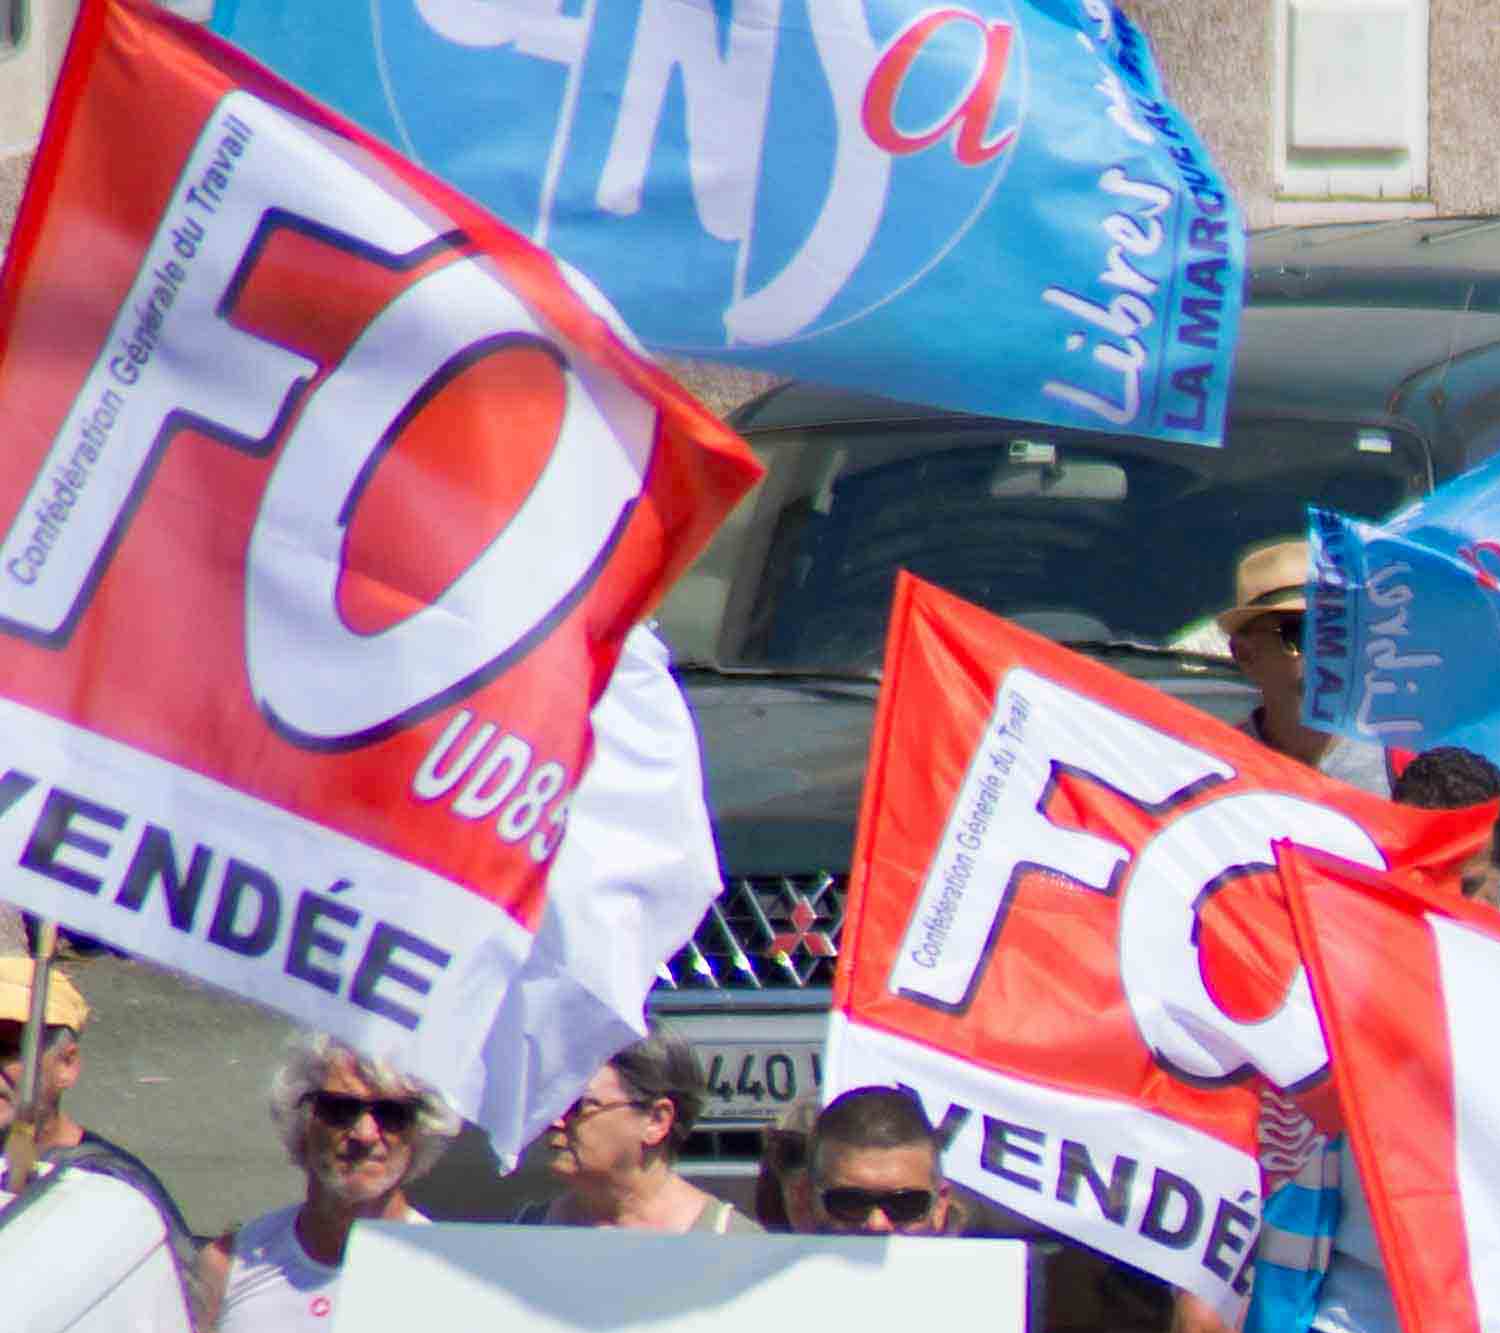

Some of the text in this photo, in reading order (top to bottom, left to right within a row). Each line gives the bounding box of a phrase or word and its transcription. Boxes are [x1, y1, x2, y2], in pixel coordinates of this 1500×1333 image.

[172, 211, 206, 264] du
[187, 115, 256, 224] Travail
[108, 256, 188, 389] Générale
[1042, 166, 1174, 426] Libres
[0, 90, 656, 753] FO
[1163, 361, 1214, 432] LA
[888, 666, 1389, 1090] FO
[928, 1098, 1257, 1299] VENDÉ
